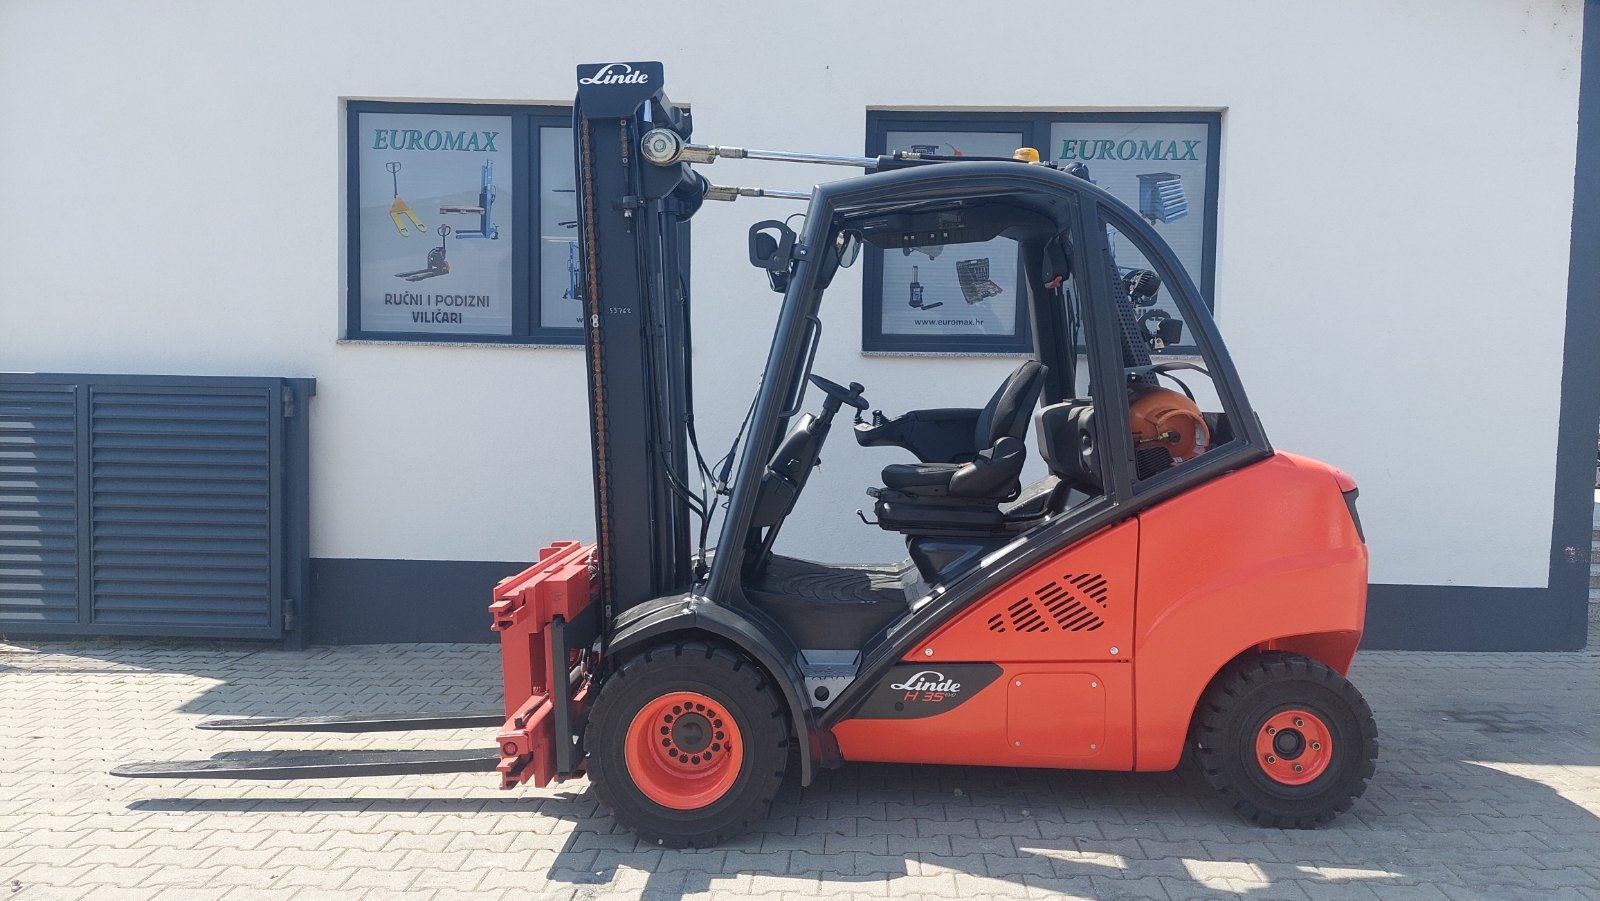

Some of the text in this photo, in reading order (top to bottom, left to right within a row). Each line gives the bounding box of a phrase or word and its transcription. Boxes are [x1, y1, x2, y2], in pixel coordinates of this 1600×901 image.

[580, 63, 648, 84] Linde
[372, 129, 500, 152] EUROMAX
[1059, 139, 1201, 161] EUROMAX
[384, 290, 423, 306] RUČNI
[435, 295, 490, 308] PODIZNI
[412, 308, 462, 324] VILIČARI
[914, 318, 984, 326] www.euromax.hr
[890, 671, 961, 692] Linde
[904, 691, 919, 701] H
[922, 691, 945, 702] 35
